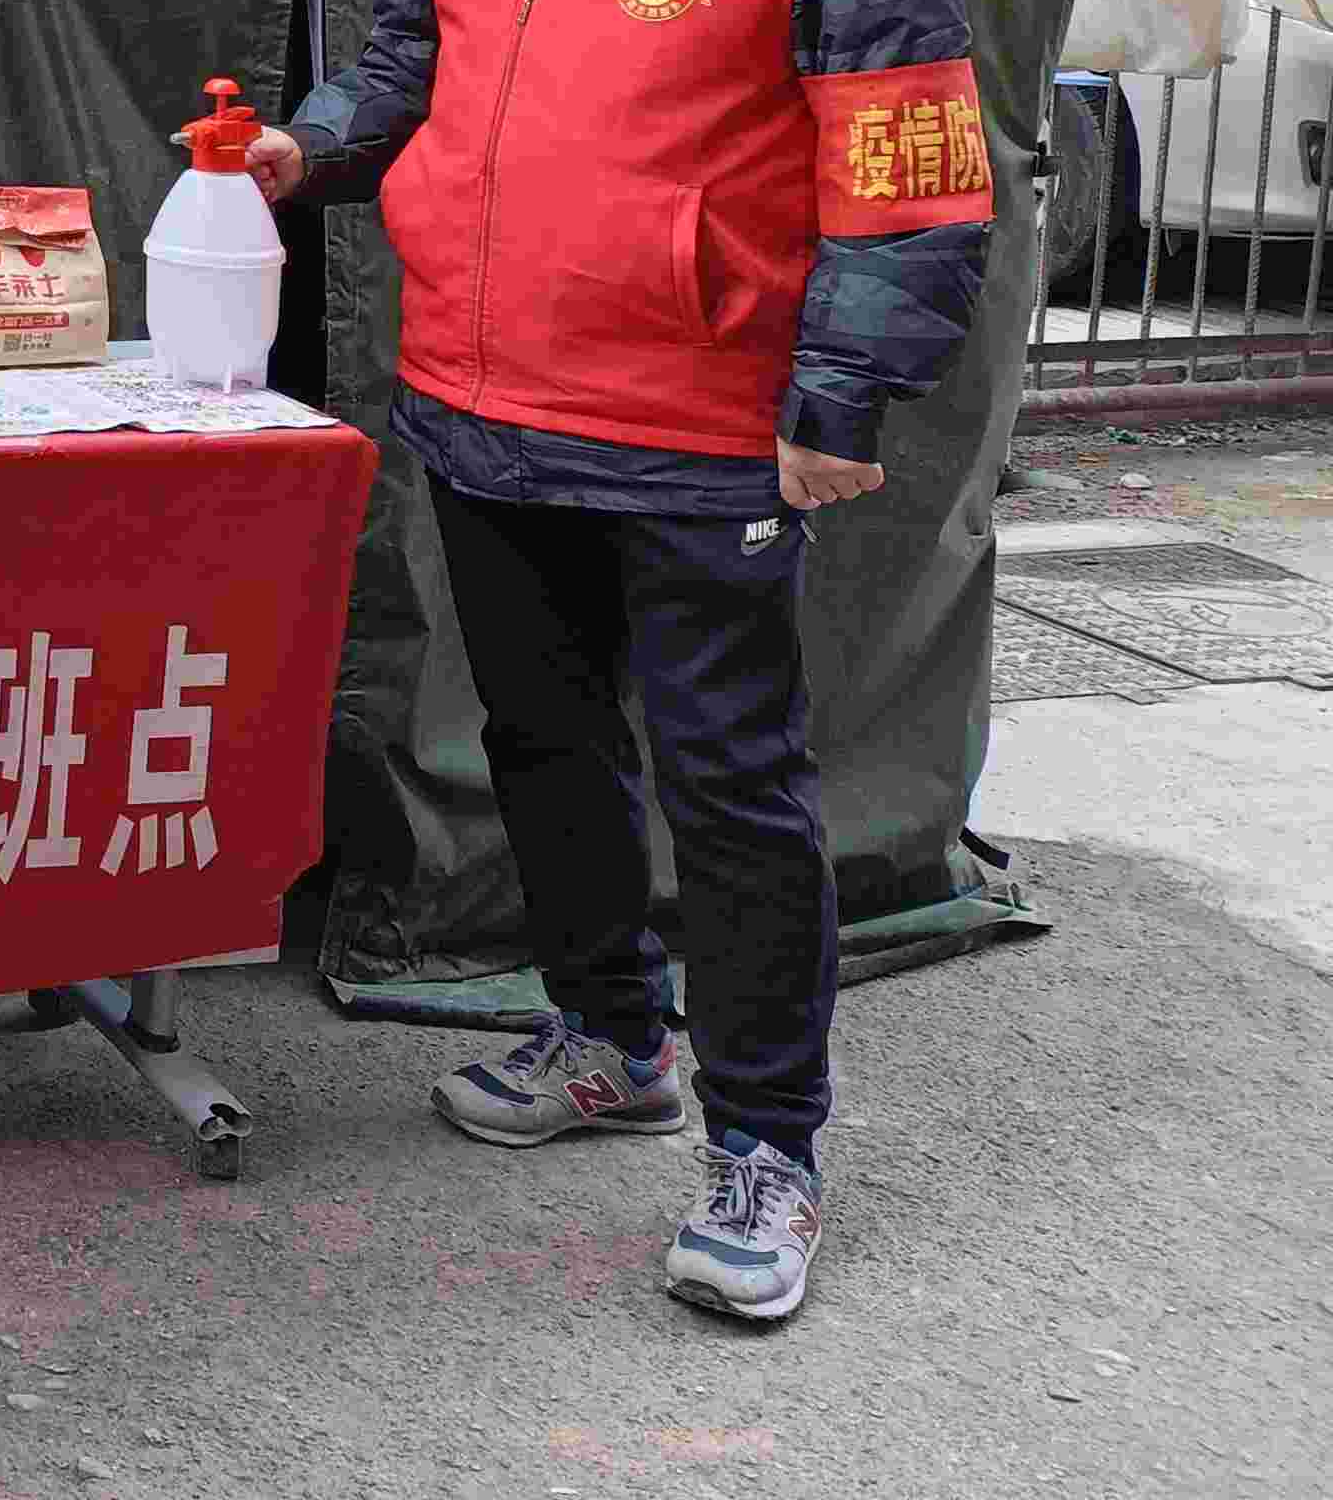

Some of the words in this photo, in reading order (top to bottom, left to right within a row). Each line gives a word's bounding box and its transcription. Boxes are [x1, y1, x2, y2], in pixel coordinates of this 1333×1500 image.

[848, 93, 985, 199] 疫情防
[745, 518, 780, 542] NIKE
